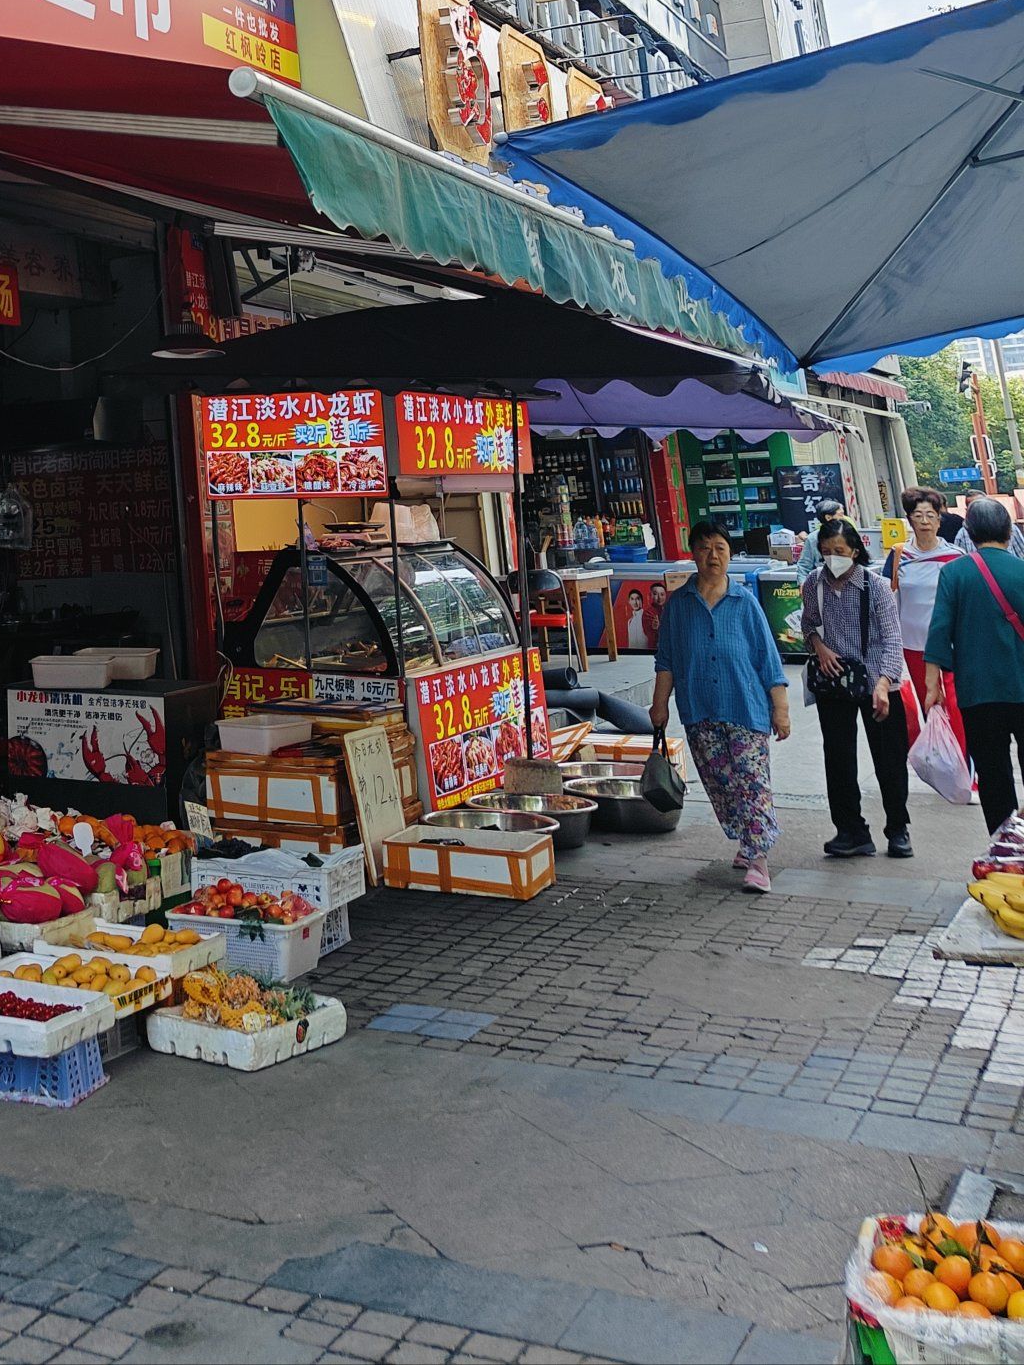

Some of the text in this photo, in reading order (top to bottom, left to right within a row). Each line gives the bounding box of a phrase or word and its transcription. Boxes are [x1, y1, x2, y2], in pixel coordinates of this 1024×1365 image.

[222, 5, 280, 44] 一件也批发
[225, 27, 281, 72] 红枫岭店
[207, 391, 375, 422] 潜江淡水小龙虾
[402, 394, 484, 425] 潜江淡水小龙虾
[12, 445, 169, 476] 肖记老卤坊简阳羊肉汤
[420, 662, 500, 705] 潜江淡水小龙虾
